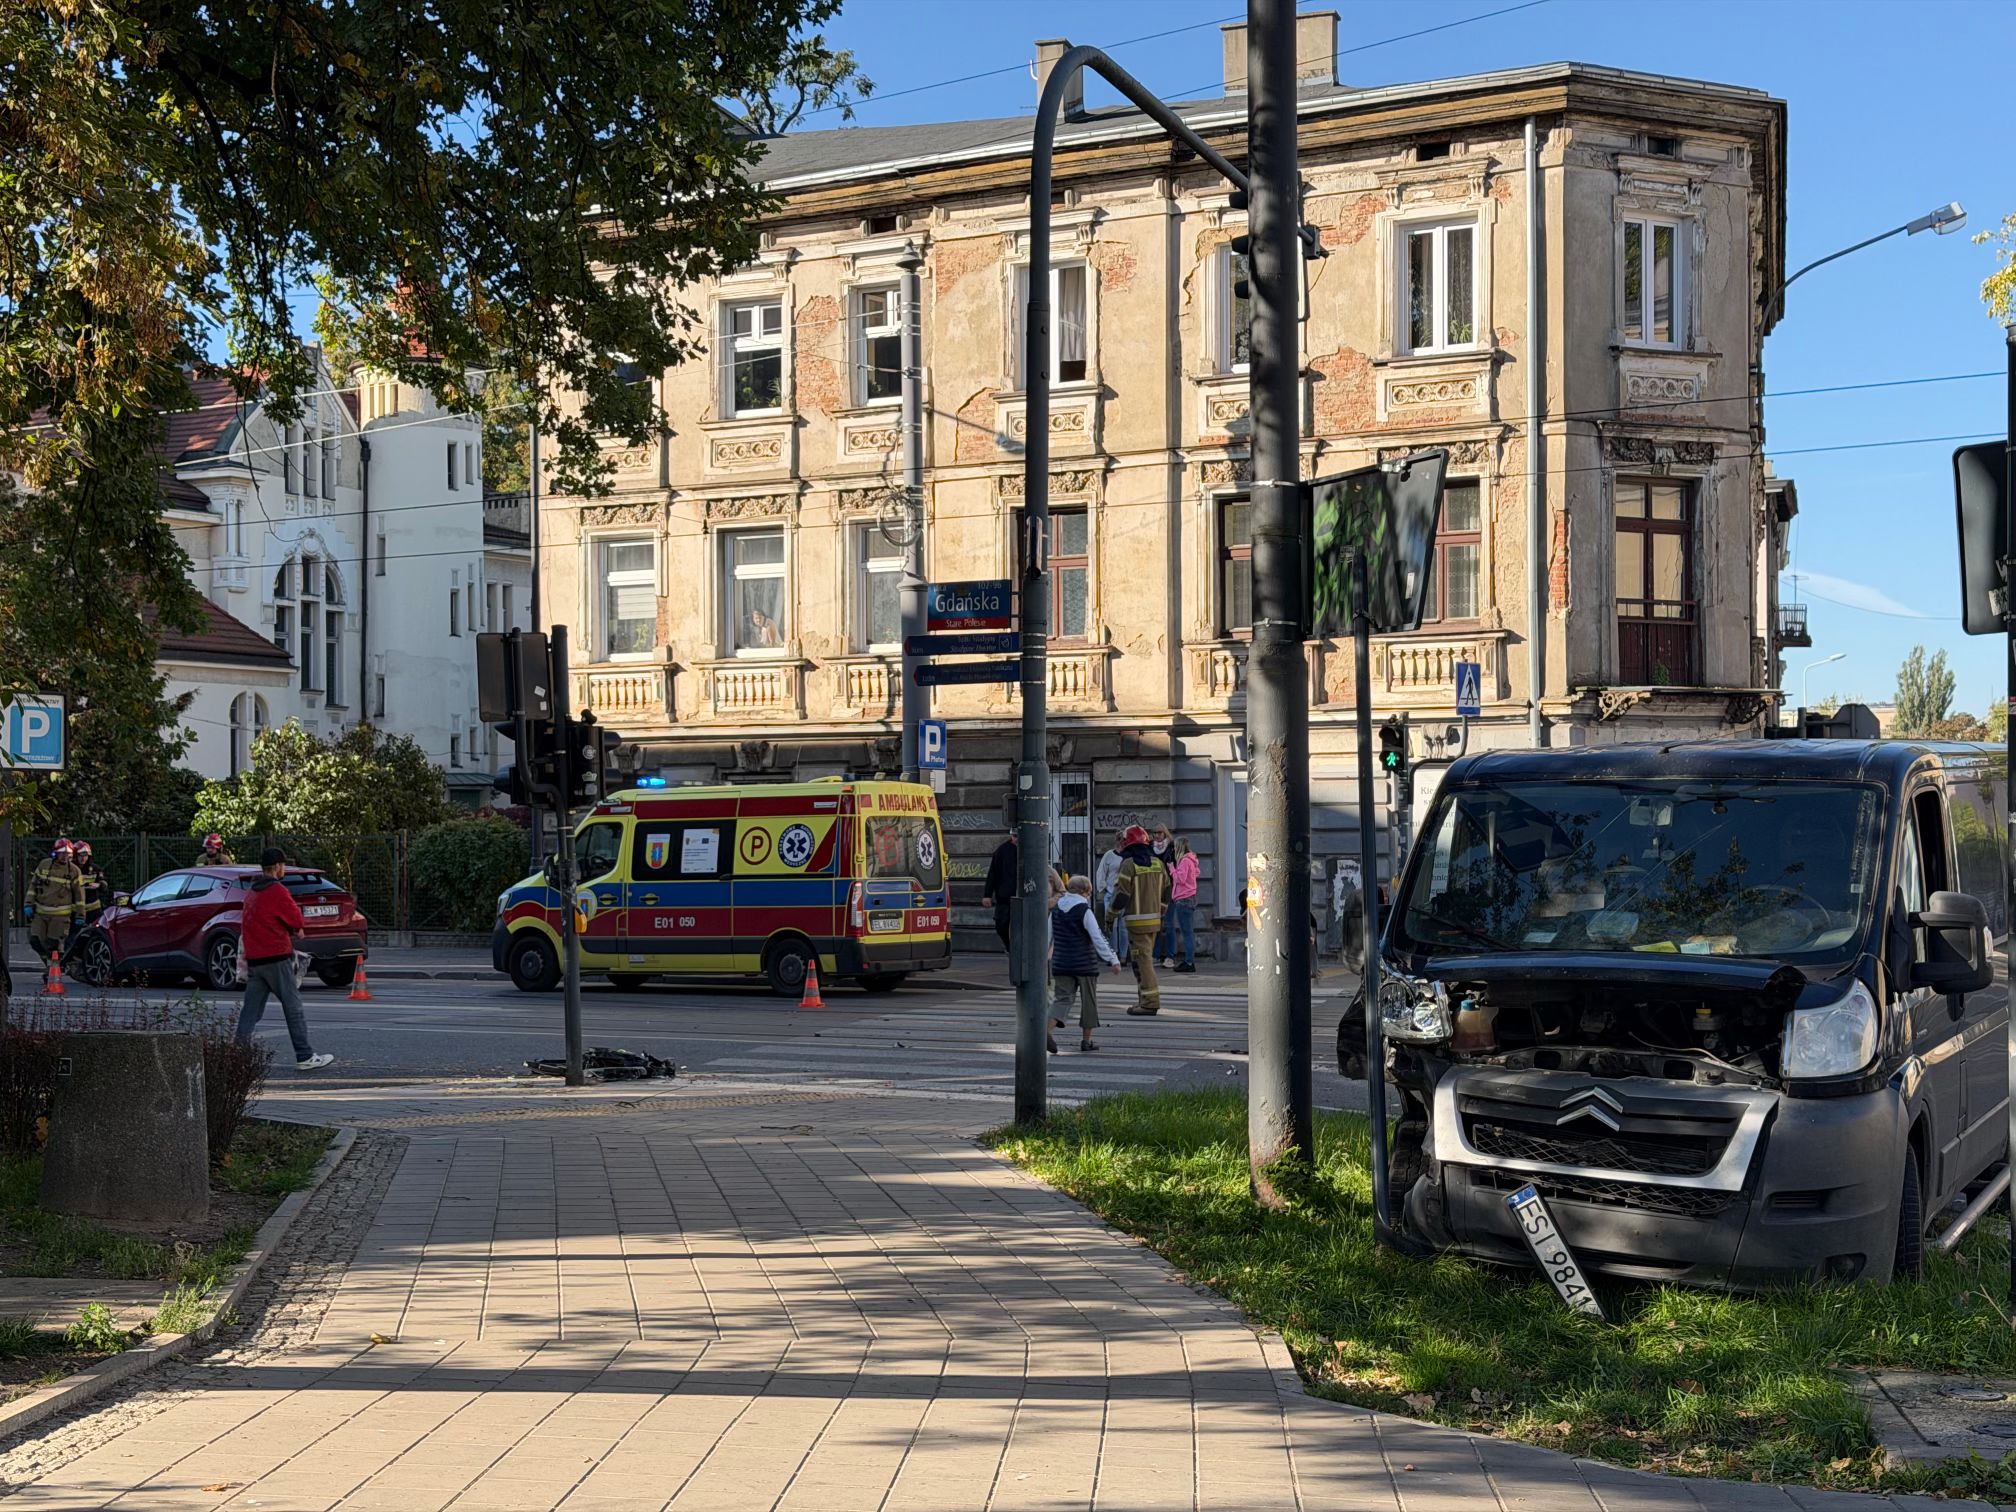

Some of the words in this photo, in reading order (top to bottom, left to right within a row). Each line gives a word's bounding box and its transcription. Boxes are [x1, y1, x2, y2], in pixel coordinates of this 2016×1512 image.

[935, 590, 1000, 613] Gdańska
[22, 710, 50, 754] P
[925, 725, 941, 762] P
[878, 794, 927, 813] AMBULANS
[751, 835, 764, 857] P
[654, 917, 674, 929] E01
[679, 916, 696, 927] 050
[917, 916, 929, 927] E01
[1516, 1199, 1556, 1246] ESI
